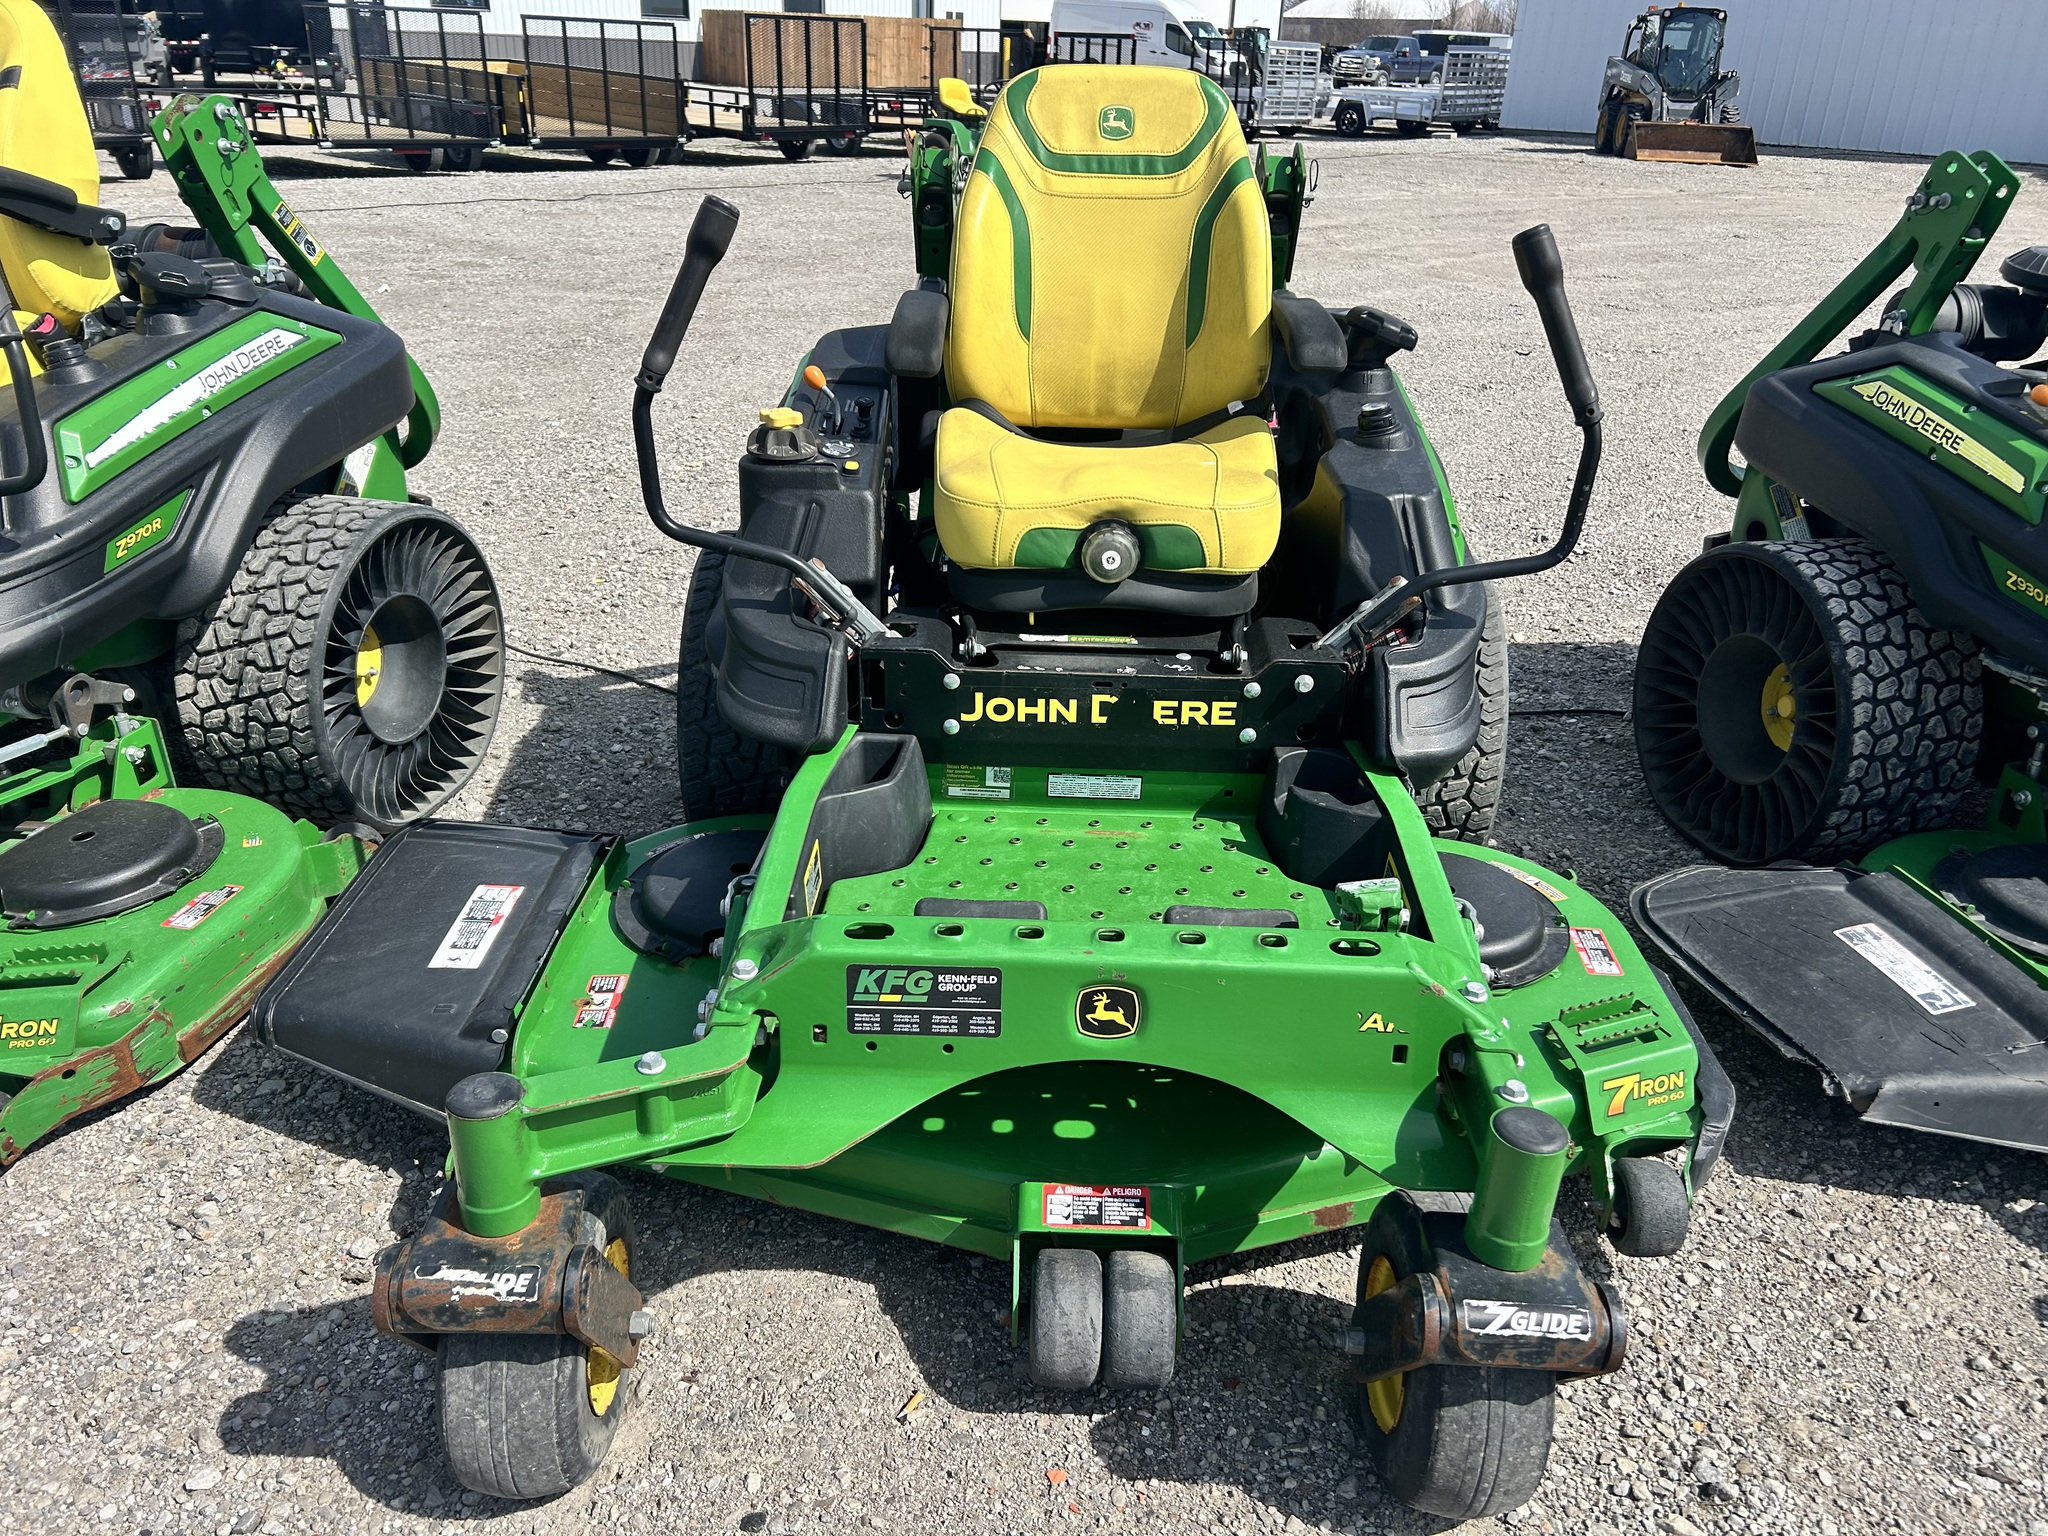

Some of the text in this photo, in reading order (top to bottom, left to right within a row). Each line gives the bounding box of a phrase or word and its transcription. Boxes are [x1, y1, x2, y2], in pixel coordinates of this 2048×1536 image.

[198, 335, 285, 393] JOHN DEERE
[1865, 384, 1966, 452] JOHN DEERE
[115, 517, 162, 559] Z970R
[960, 692, 1237, 725] JOHN DERE
[854, 969, 934, 995] KFG
[938, 974, 998, 984] KENN-FELD
[938, 983, 977, 992] GROUP
[9, 1040, 35, 1049] PRO
[1647, 1090, 1685, 1107] PRO 60
[1065, 1186, 1093, 1195] DANGER
[1112, 1188, 1142, 1196] PELIGRO
